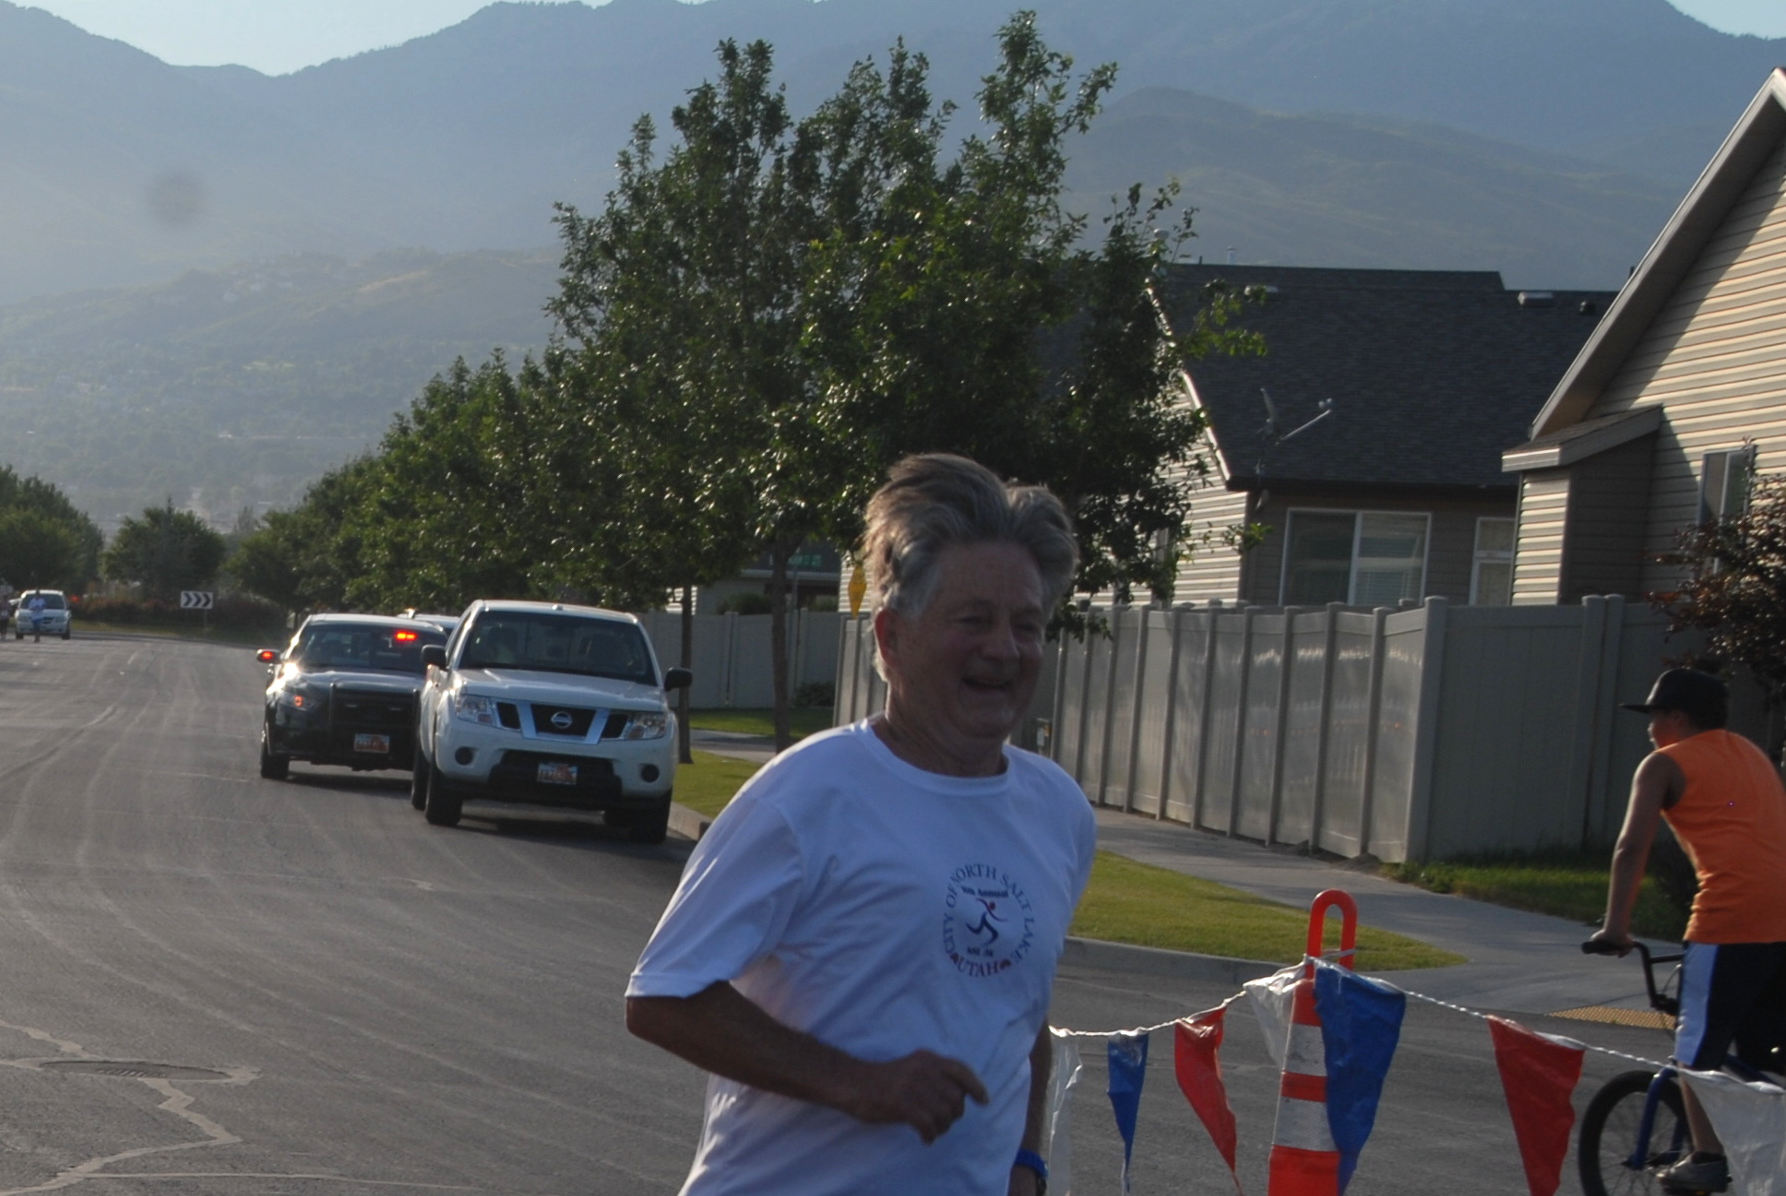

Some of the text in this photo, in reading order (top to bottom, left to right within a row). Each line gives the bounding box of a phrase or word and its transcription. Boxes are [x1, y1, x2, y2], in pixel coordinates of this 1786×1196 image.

[943, 863, 1035, 962] CITY OF NORTH SALT LAKE
[957, 956, 998, 977] UTAH
